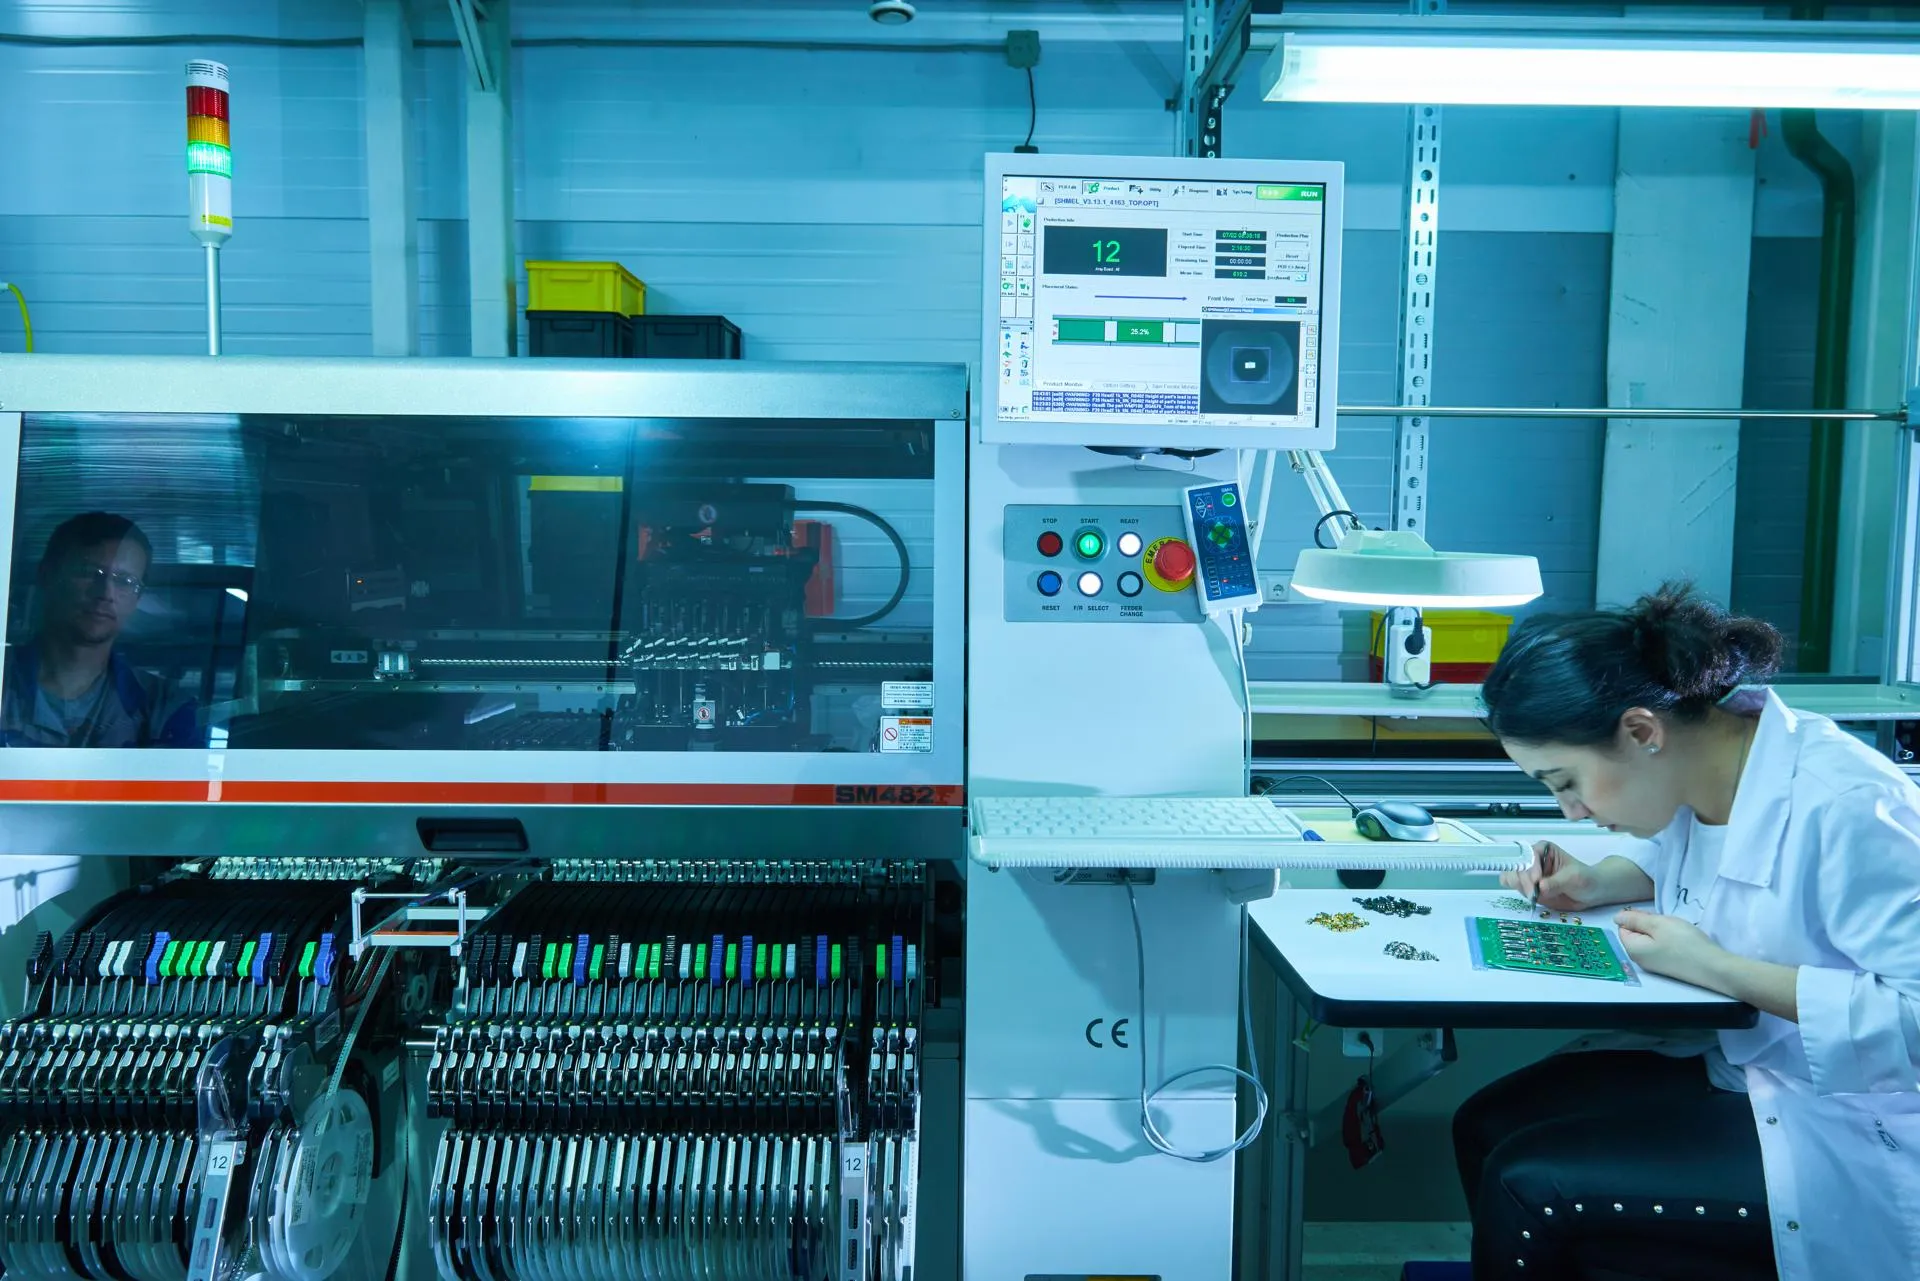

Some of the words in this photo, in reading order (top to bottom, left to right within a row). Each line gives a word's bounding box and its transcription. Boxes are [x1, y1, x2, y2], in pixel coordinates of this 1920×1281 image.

[1093, 240, 1120, 262] 12
[1130, 328, 1149, 336] 25.2%
[836, 785, 935, 803] SM482
[1086, 1018, 1128, 1048] CE
[212, 1155, 228, 1169] 12
[845, 1157, 862, 1171] 12
